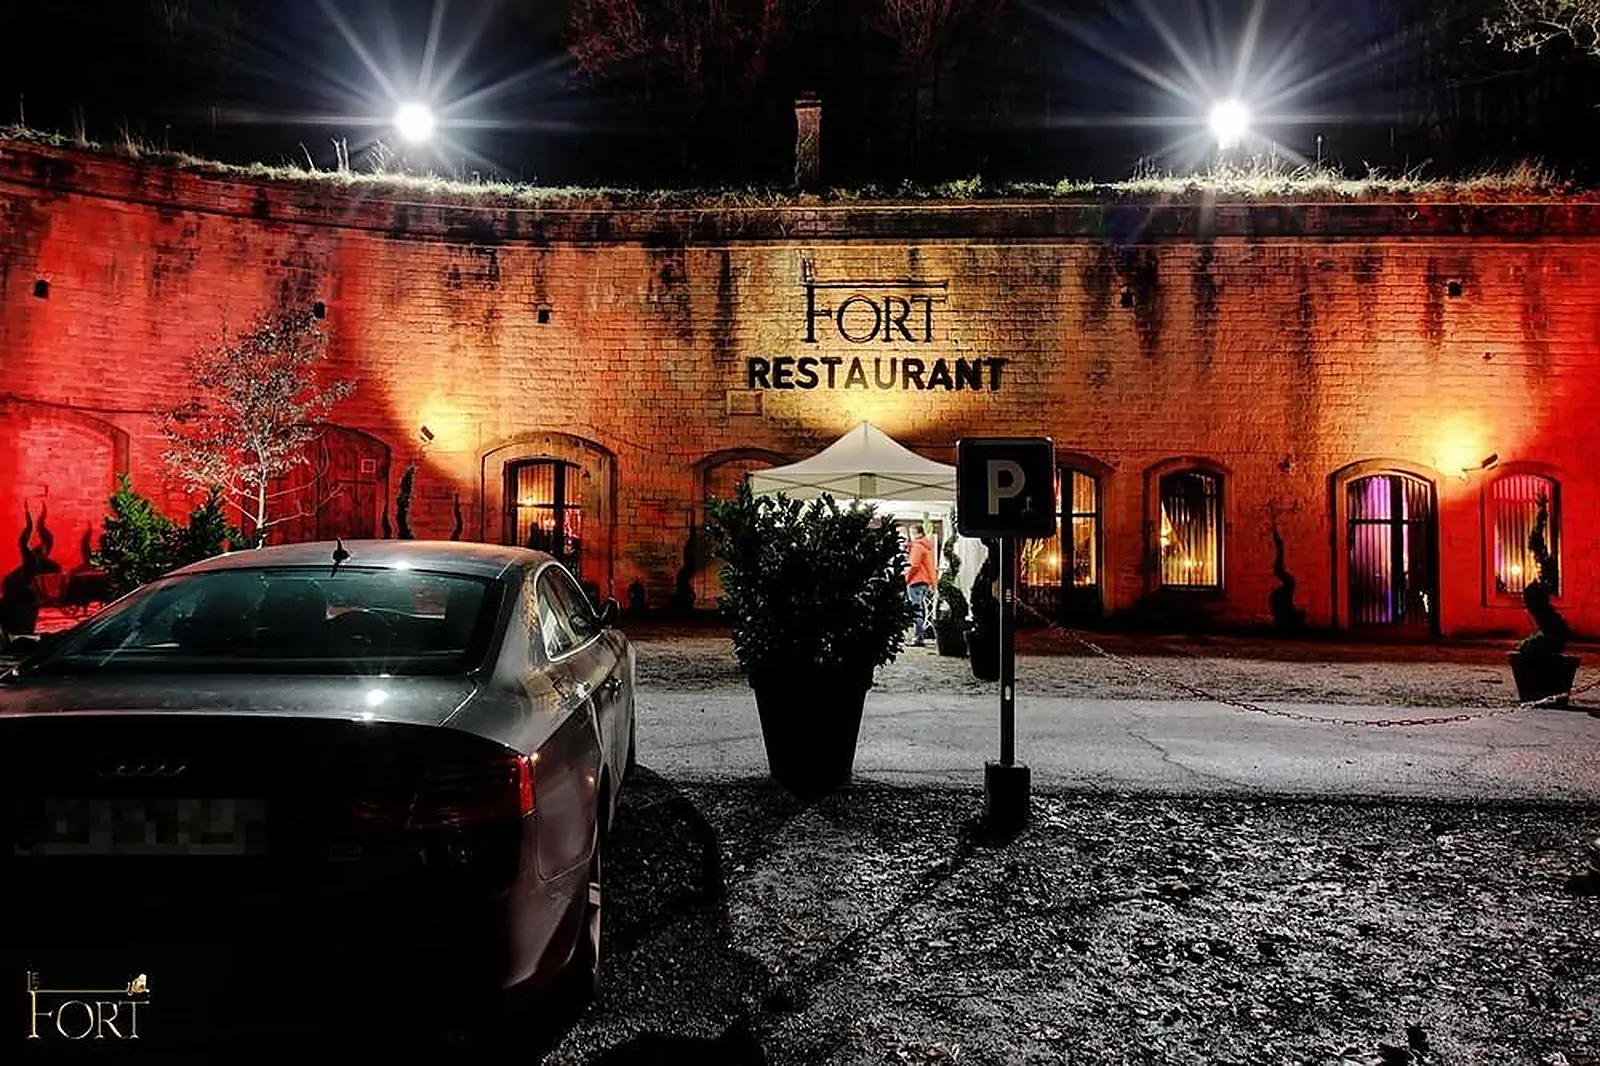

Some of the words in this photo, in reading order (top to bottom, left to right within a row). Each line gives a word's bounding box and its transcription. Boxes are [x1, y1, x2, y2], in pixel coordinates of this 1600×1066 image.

[804, 280, 948, 343] FORT
[749, 356, 1006, 390] RESTAURANT
[987, 460, 1026, 515] P
